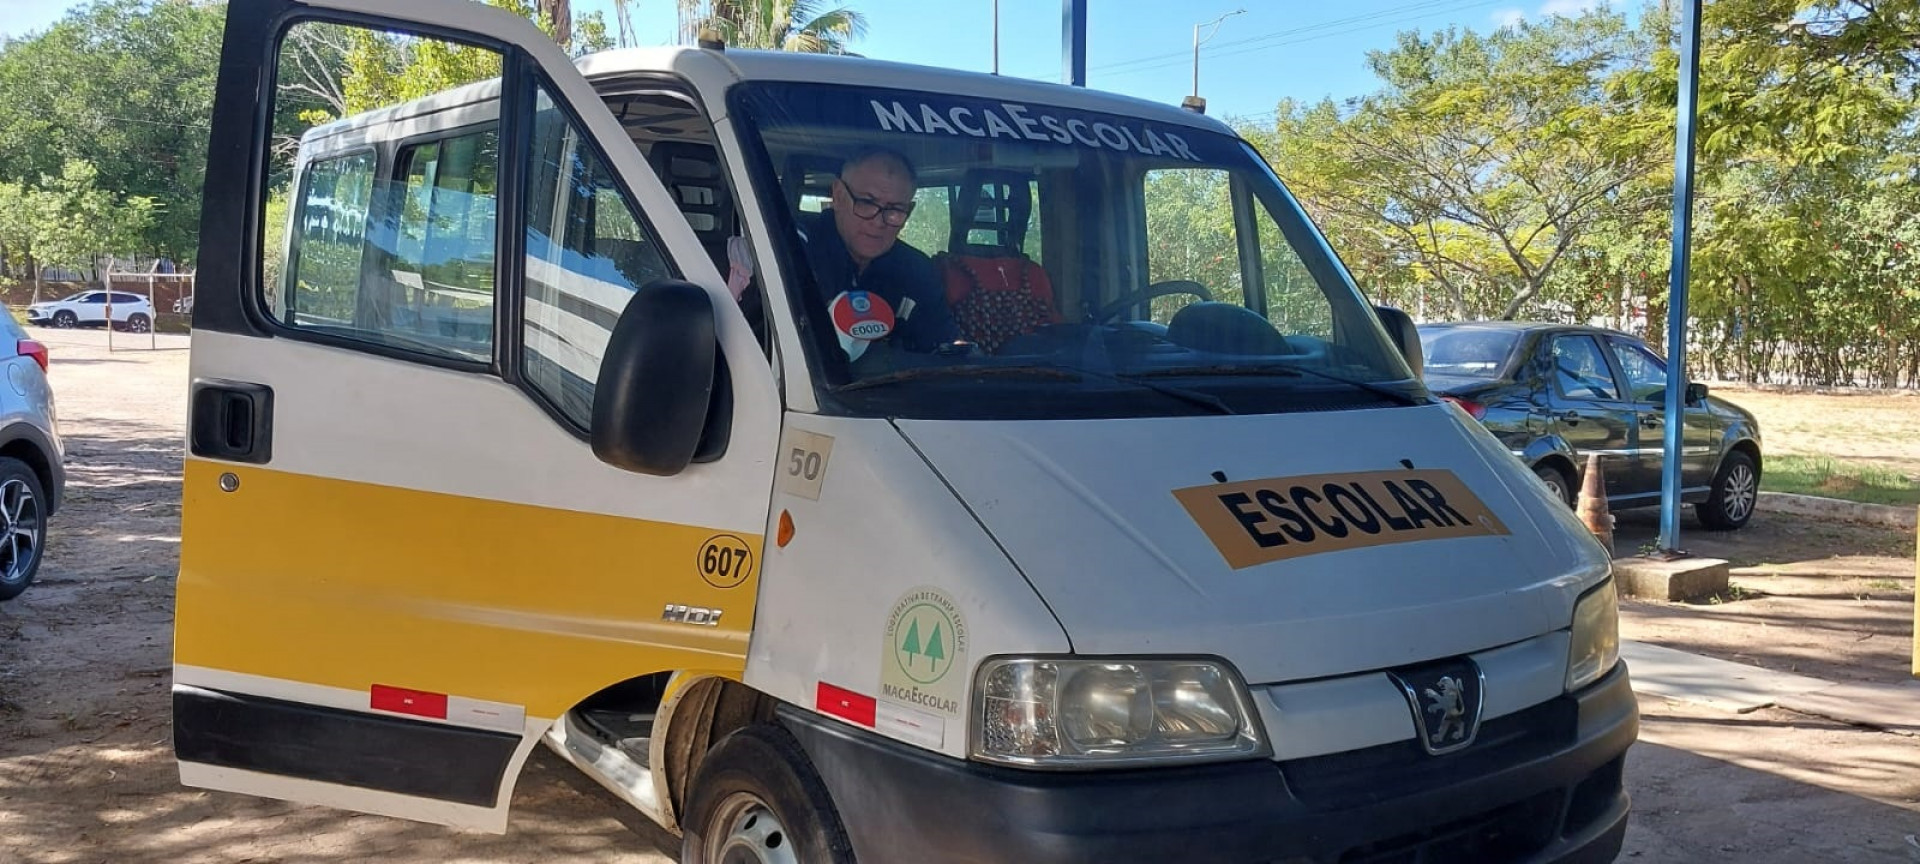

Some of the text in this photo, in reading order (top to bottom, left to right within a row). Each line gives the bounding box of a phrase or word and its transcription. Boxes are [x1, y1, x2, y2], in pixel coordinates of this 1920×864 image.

[870, 99, 1201, 162] MACAESCOLAR
[852, 323, 888, 336] E0001
[788, 448, 822, 481] 50
[1217, 479, 1473, 548] ESCOLAR
[703, 544, 747, 578] 607
[662, 604, 723, 626] HDI
